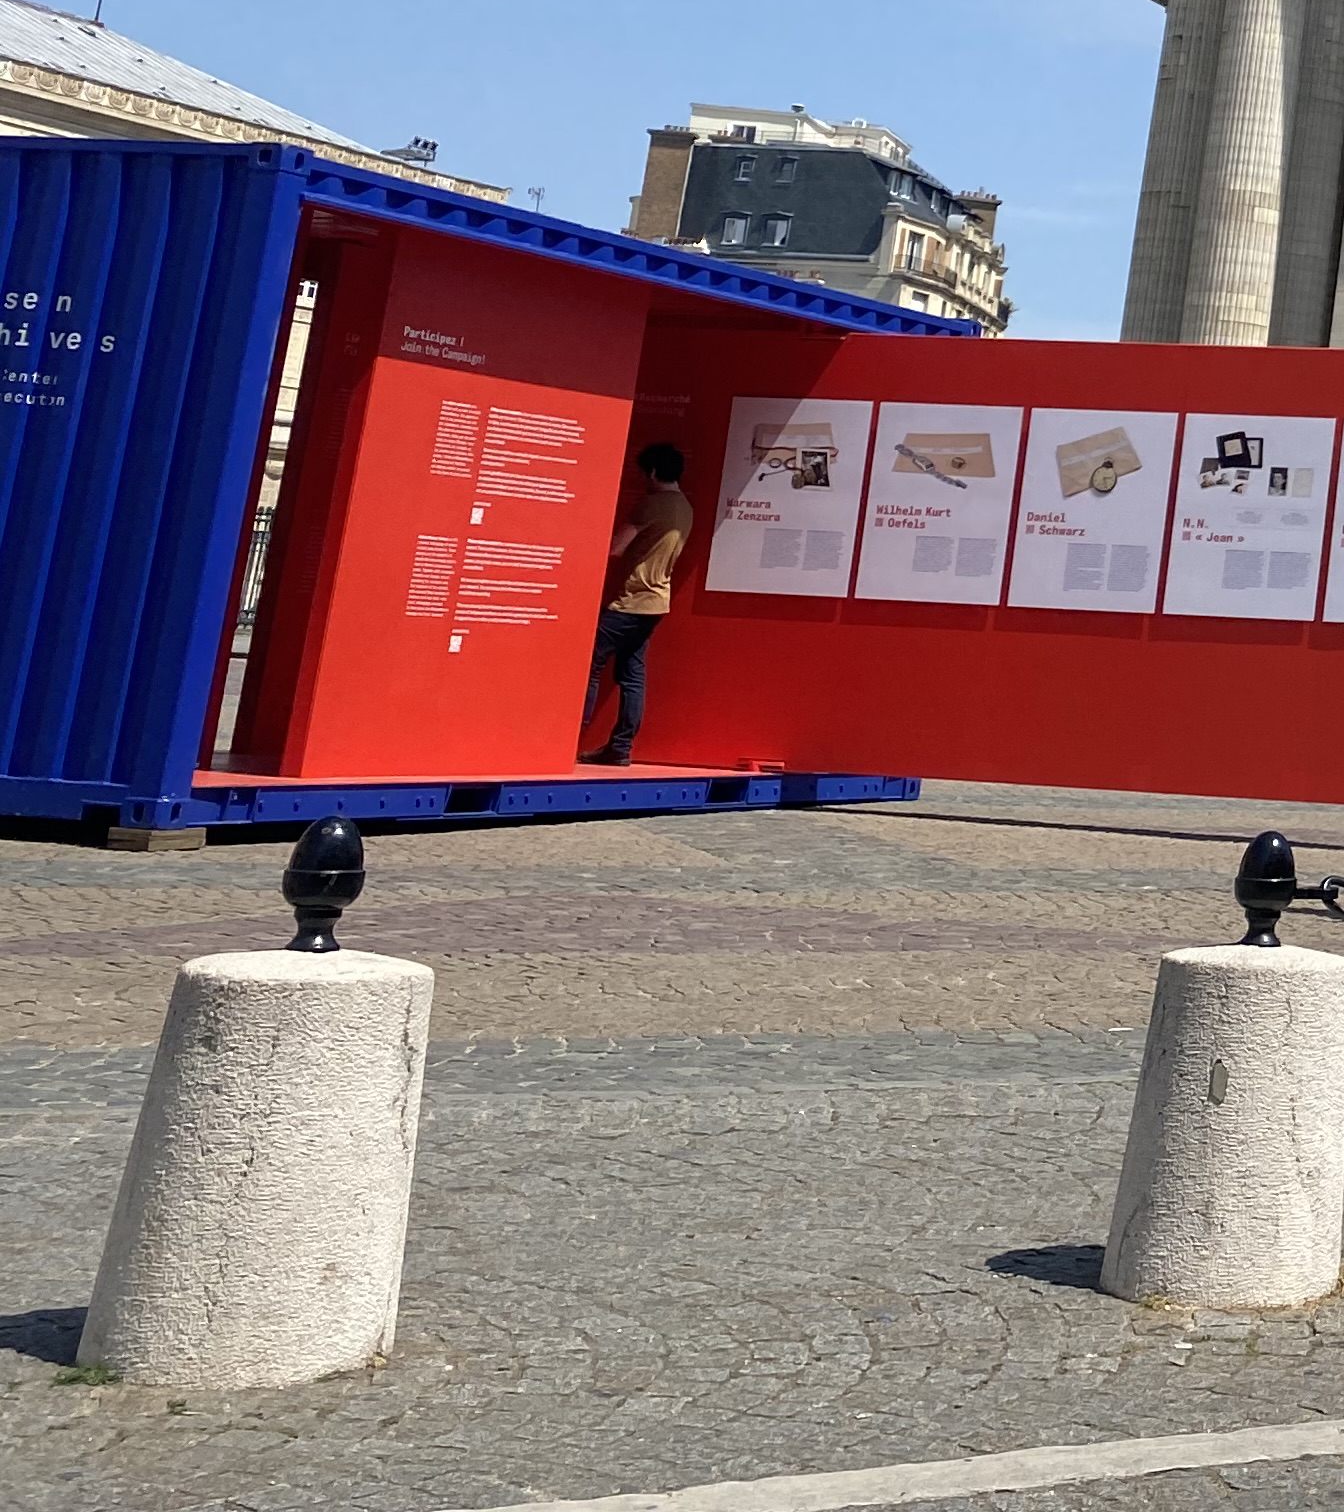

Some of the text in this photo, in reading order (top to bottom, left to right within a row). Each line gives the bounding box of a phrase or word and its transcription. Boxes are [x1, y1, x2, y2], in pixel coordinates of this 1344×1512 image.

[403, 325, 456, 345] Participez
[401, 342, 486, 366] Join the Campaign!
[737, 510, 780, 522] Zenzura
[876, 504, 951, 517] Wilhelm Kurt
[1026, 511, 1066, 523] Daniel
[887, 518, 926, 529] Oefels
[1038, 524, 1086, 537] Schwarz
[1206, 532, 1233, 543] Jean
